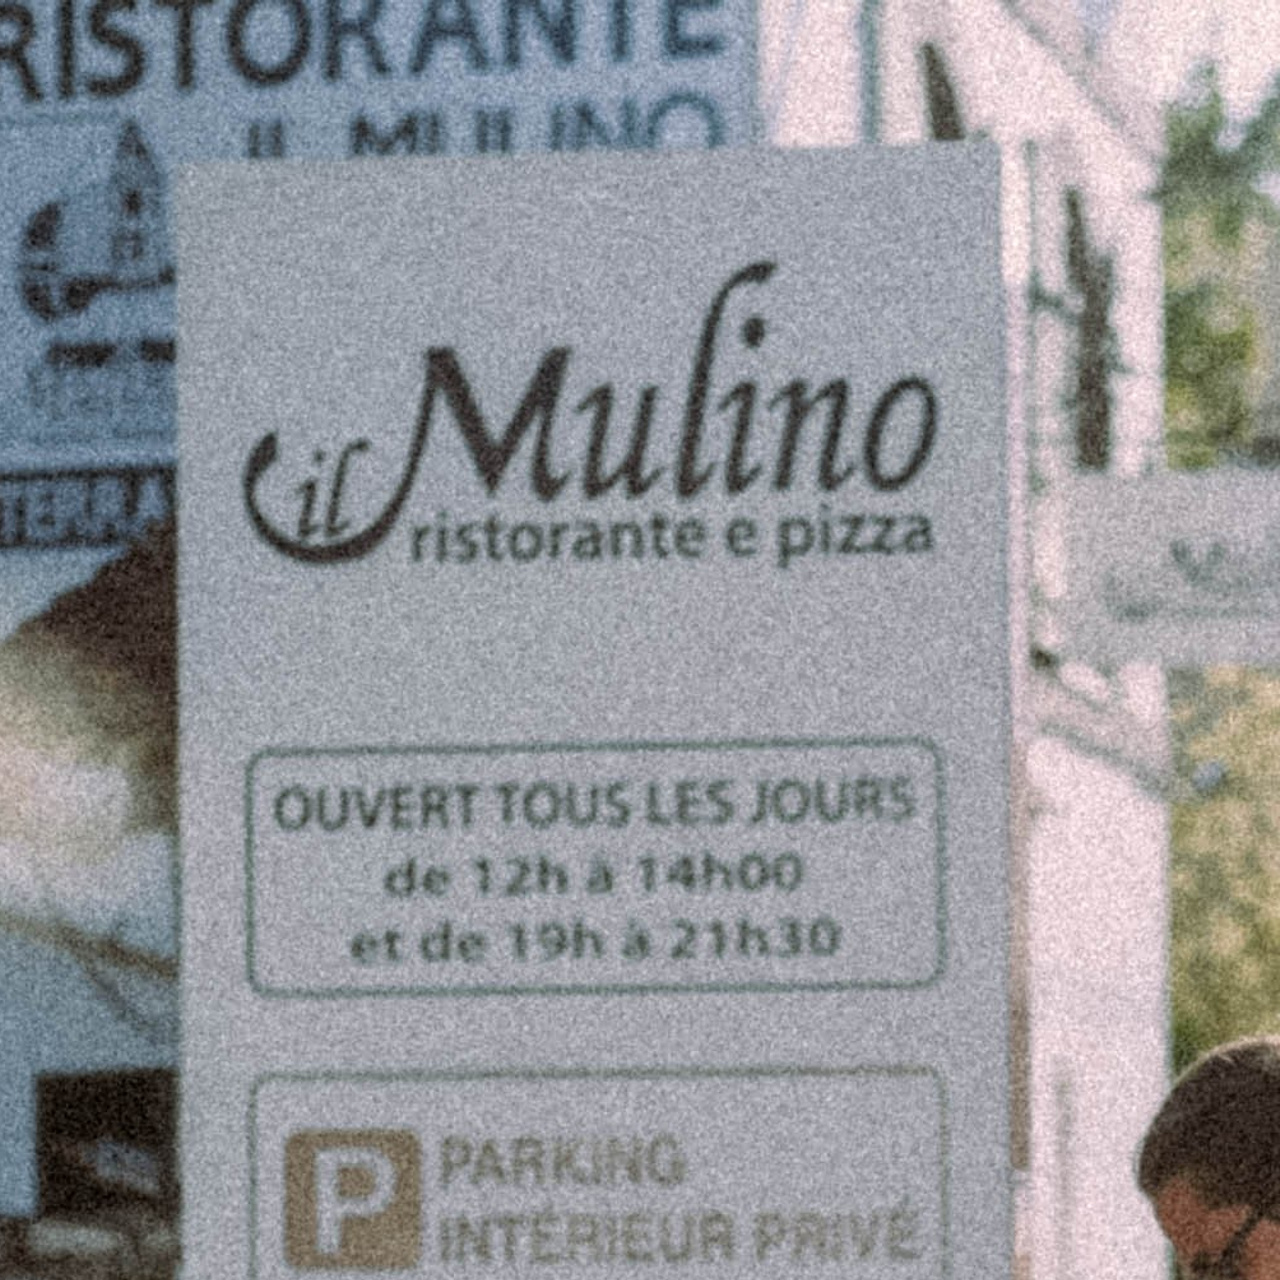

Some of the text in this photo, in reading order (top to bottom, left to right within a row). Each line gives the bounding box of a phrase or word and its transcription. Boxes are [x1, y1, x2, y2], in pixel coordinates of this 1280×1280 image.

[242, 260, 938, 567] il Mulino
[409, 504, 935, 569] ristorante e pizza
[273, 773, 916, 833] OUVERT TOUS LES JOURS
[383, 857, 450, 898] de
[473, 855, 570, 897] 12h
[638, 850, 805, 893] 14h00
[350, 915, 842, 965] et de 19h à 21h30
[438, 1133, 687, 1191] PARKING
